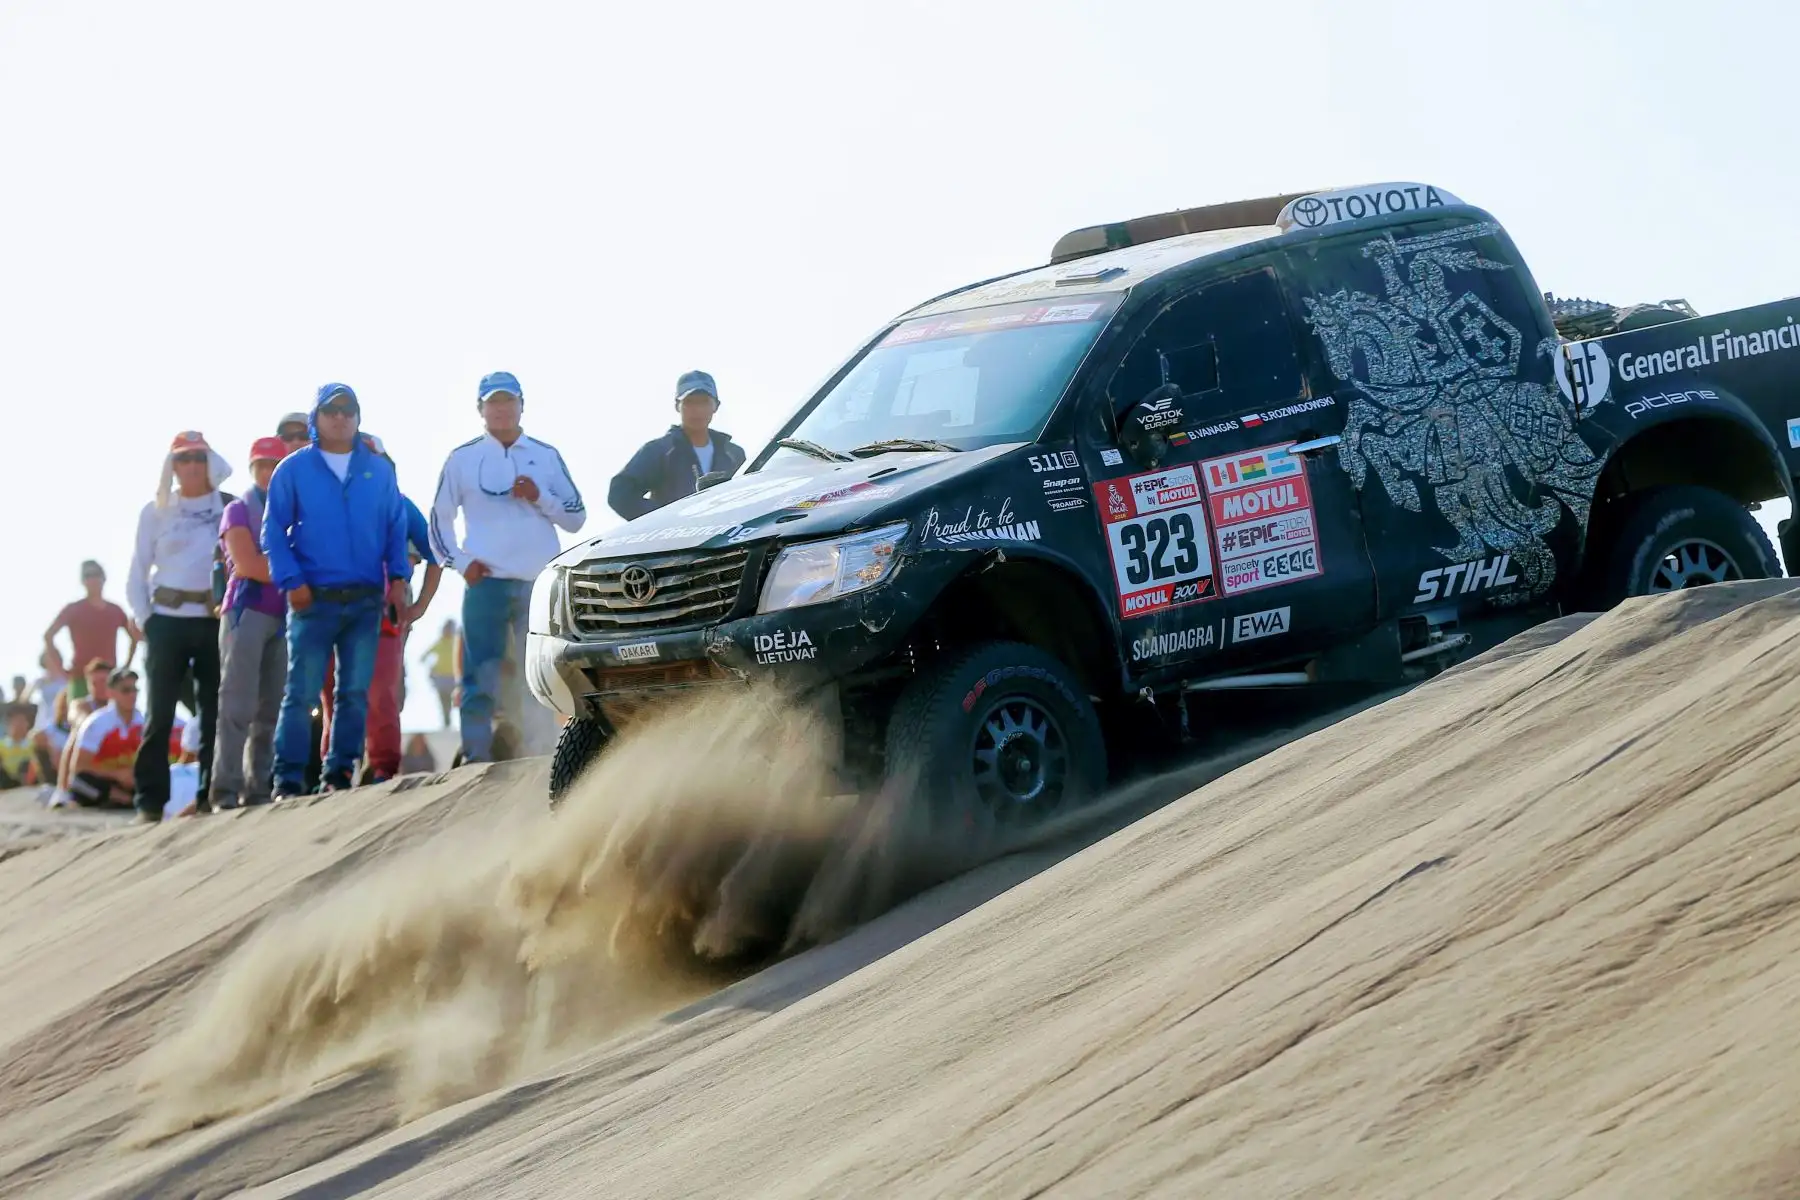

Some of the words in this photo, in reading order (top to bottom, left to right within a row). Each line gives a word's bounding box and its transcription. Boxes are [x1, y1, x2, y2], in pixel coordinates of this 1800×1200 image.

[1325, 185, 1445, 221] TOYOTA
[1618, 335, 1711, 382] General
[1710, 315, 1800, 363] Financi
[1136, 408, 1184, 425] VOSTOK
[1261, 396, 1336, 422] S.ROZWADOWSKI
[1624, 389, 1720, 420] pitlane
[1144, 417, 1179, 431] EUROPE
[1187, 420, 1240, 441] B.VANAGAS
[1027, 452, 1065, 473] 5.11
[1043, 477, 1081, 489] Snap-on
[1147, 495, 1156, 506] by
[1159, 486, 1196, 504] MOTUL
[1052, 499, 1083, 510] PROAUTO
[1223, 483, 1299, 520] MOTUL
[920, 505, 972, 543] Proud
[977, 508, 993, 529] to
[997, 496, 1015, 526] be
[1287, 527, 1311, 540] MOTUL
[1120, 512, 1199, 585] 323
[1226, 567, 1260, 588] sport
[1413, 554, 1518, 604] STIHL
[1125, 590, 1169, 612] MOTUL
[1173, 578, 1211, 600] 300V
[1238, 611, 1285, 639] EWA
[1132, 624, 1214, 662] SCANDAGRA
